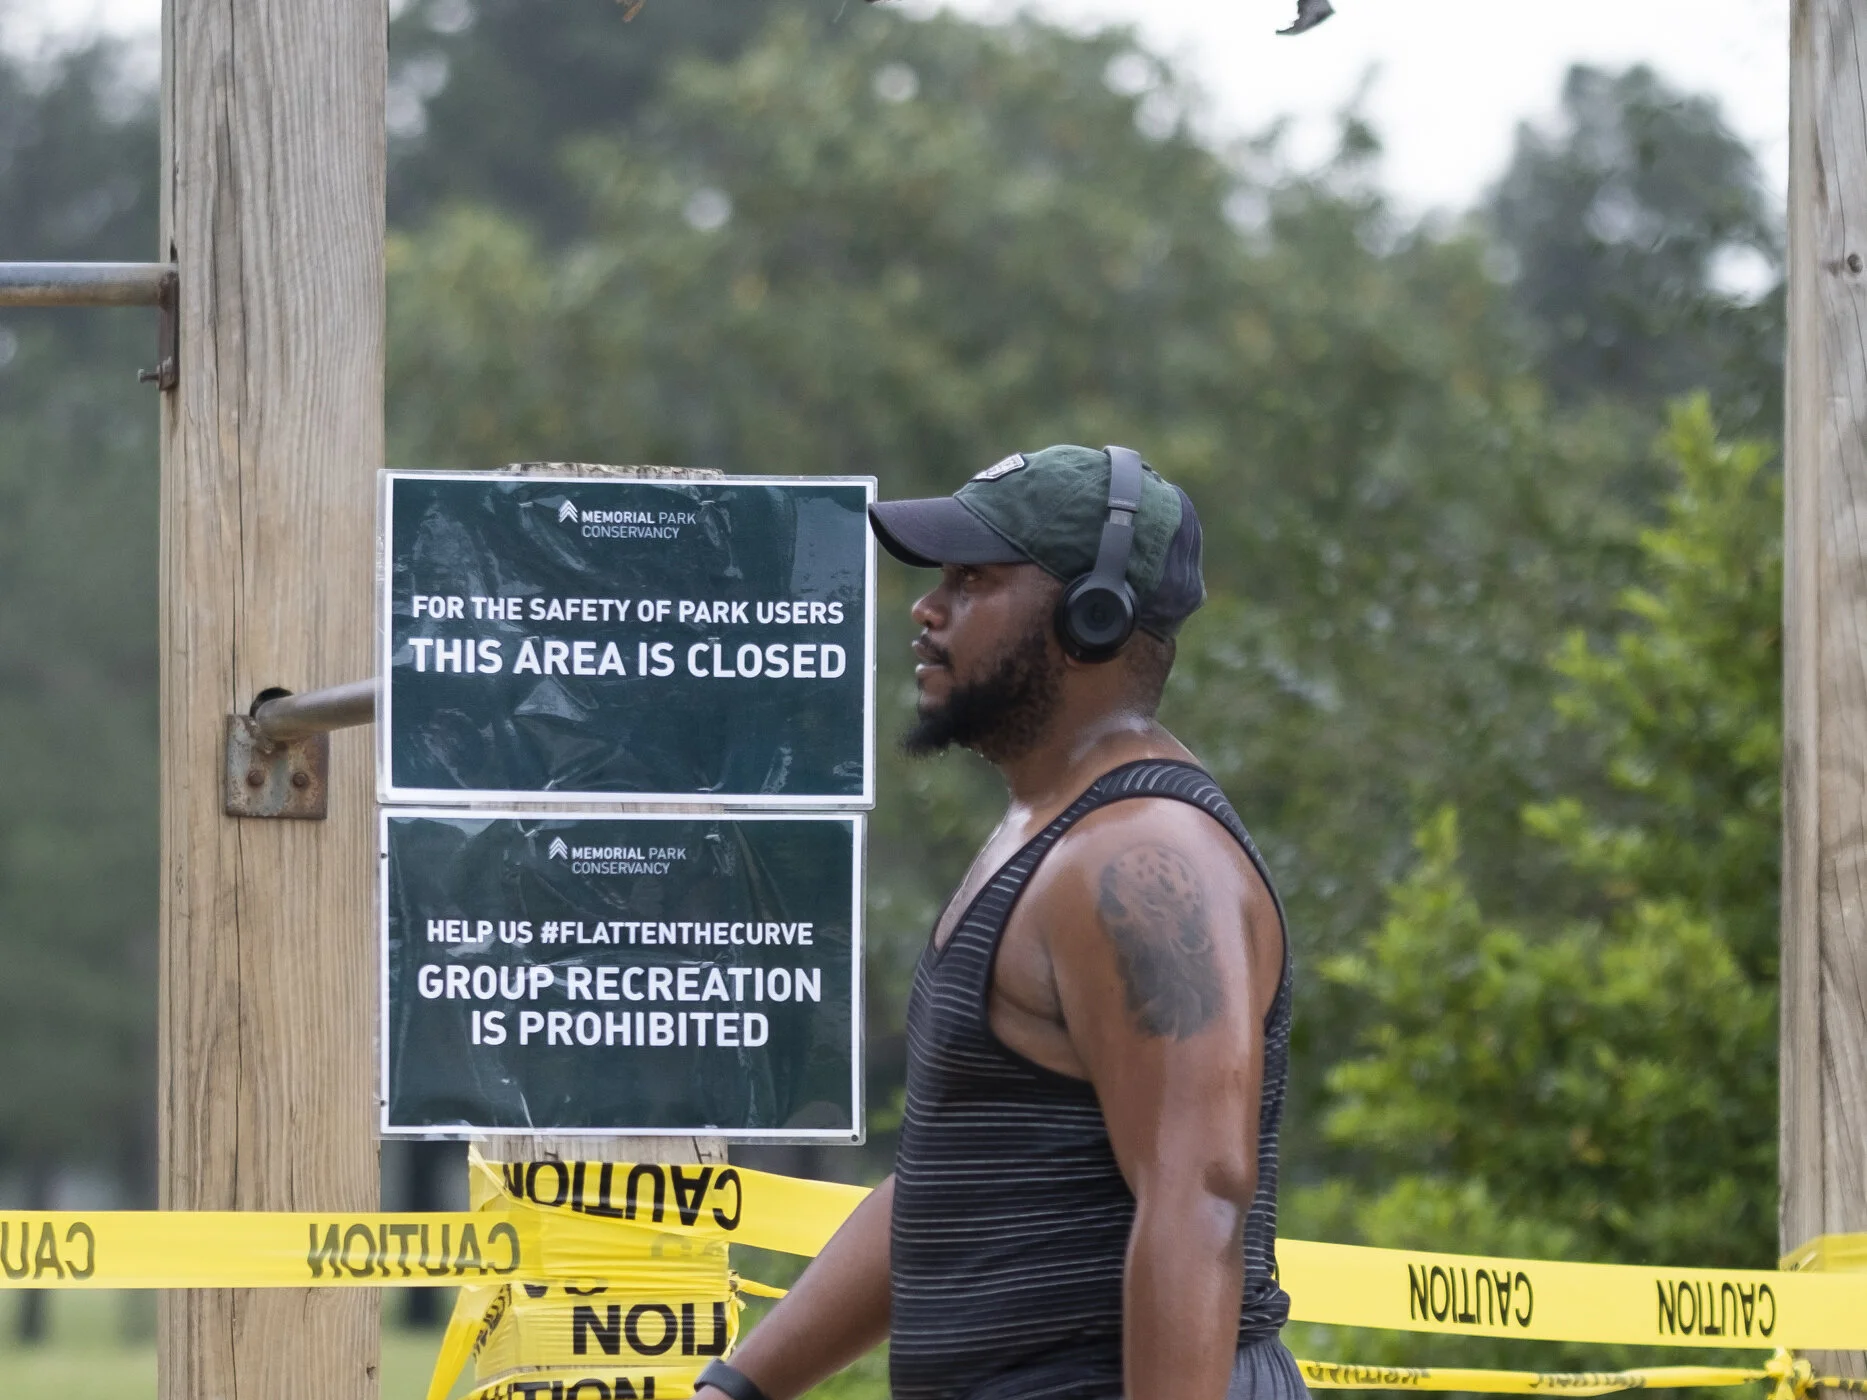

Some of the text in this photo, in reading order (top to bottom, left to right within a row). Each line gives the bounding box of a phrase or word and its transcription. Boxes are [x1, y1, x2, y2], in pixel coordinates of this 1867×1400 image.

[582, 511, 696, 525] MEMORIAL PARK
[582, 525, 680, 539] CONSERVANCY
[412, 596, 844, 624] FOR THE SAFETY OF PARK USERS
[408, 638, 847, 679] THIS AREA IS CLOSED
[571, 847, 687, 860] MEMORIAL PARK
[572, 861, 671, 875] CONSERVANCY
[427, 920, 814, 945] HELP US #FLATTENTHECURVE
[417, 964, 822, 1002] GROUP RECREATION
[471, 1011, 769, 1047] IS PROHIBITED
[503, 1160, 743, 1231] CAUTION
[1407, 1263, 1533, 1328] CAUTION
[1655, 1279, 1777, 1338] CAUTION
[572, 1302, 728, 1357] TION
